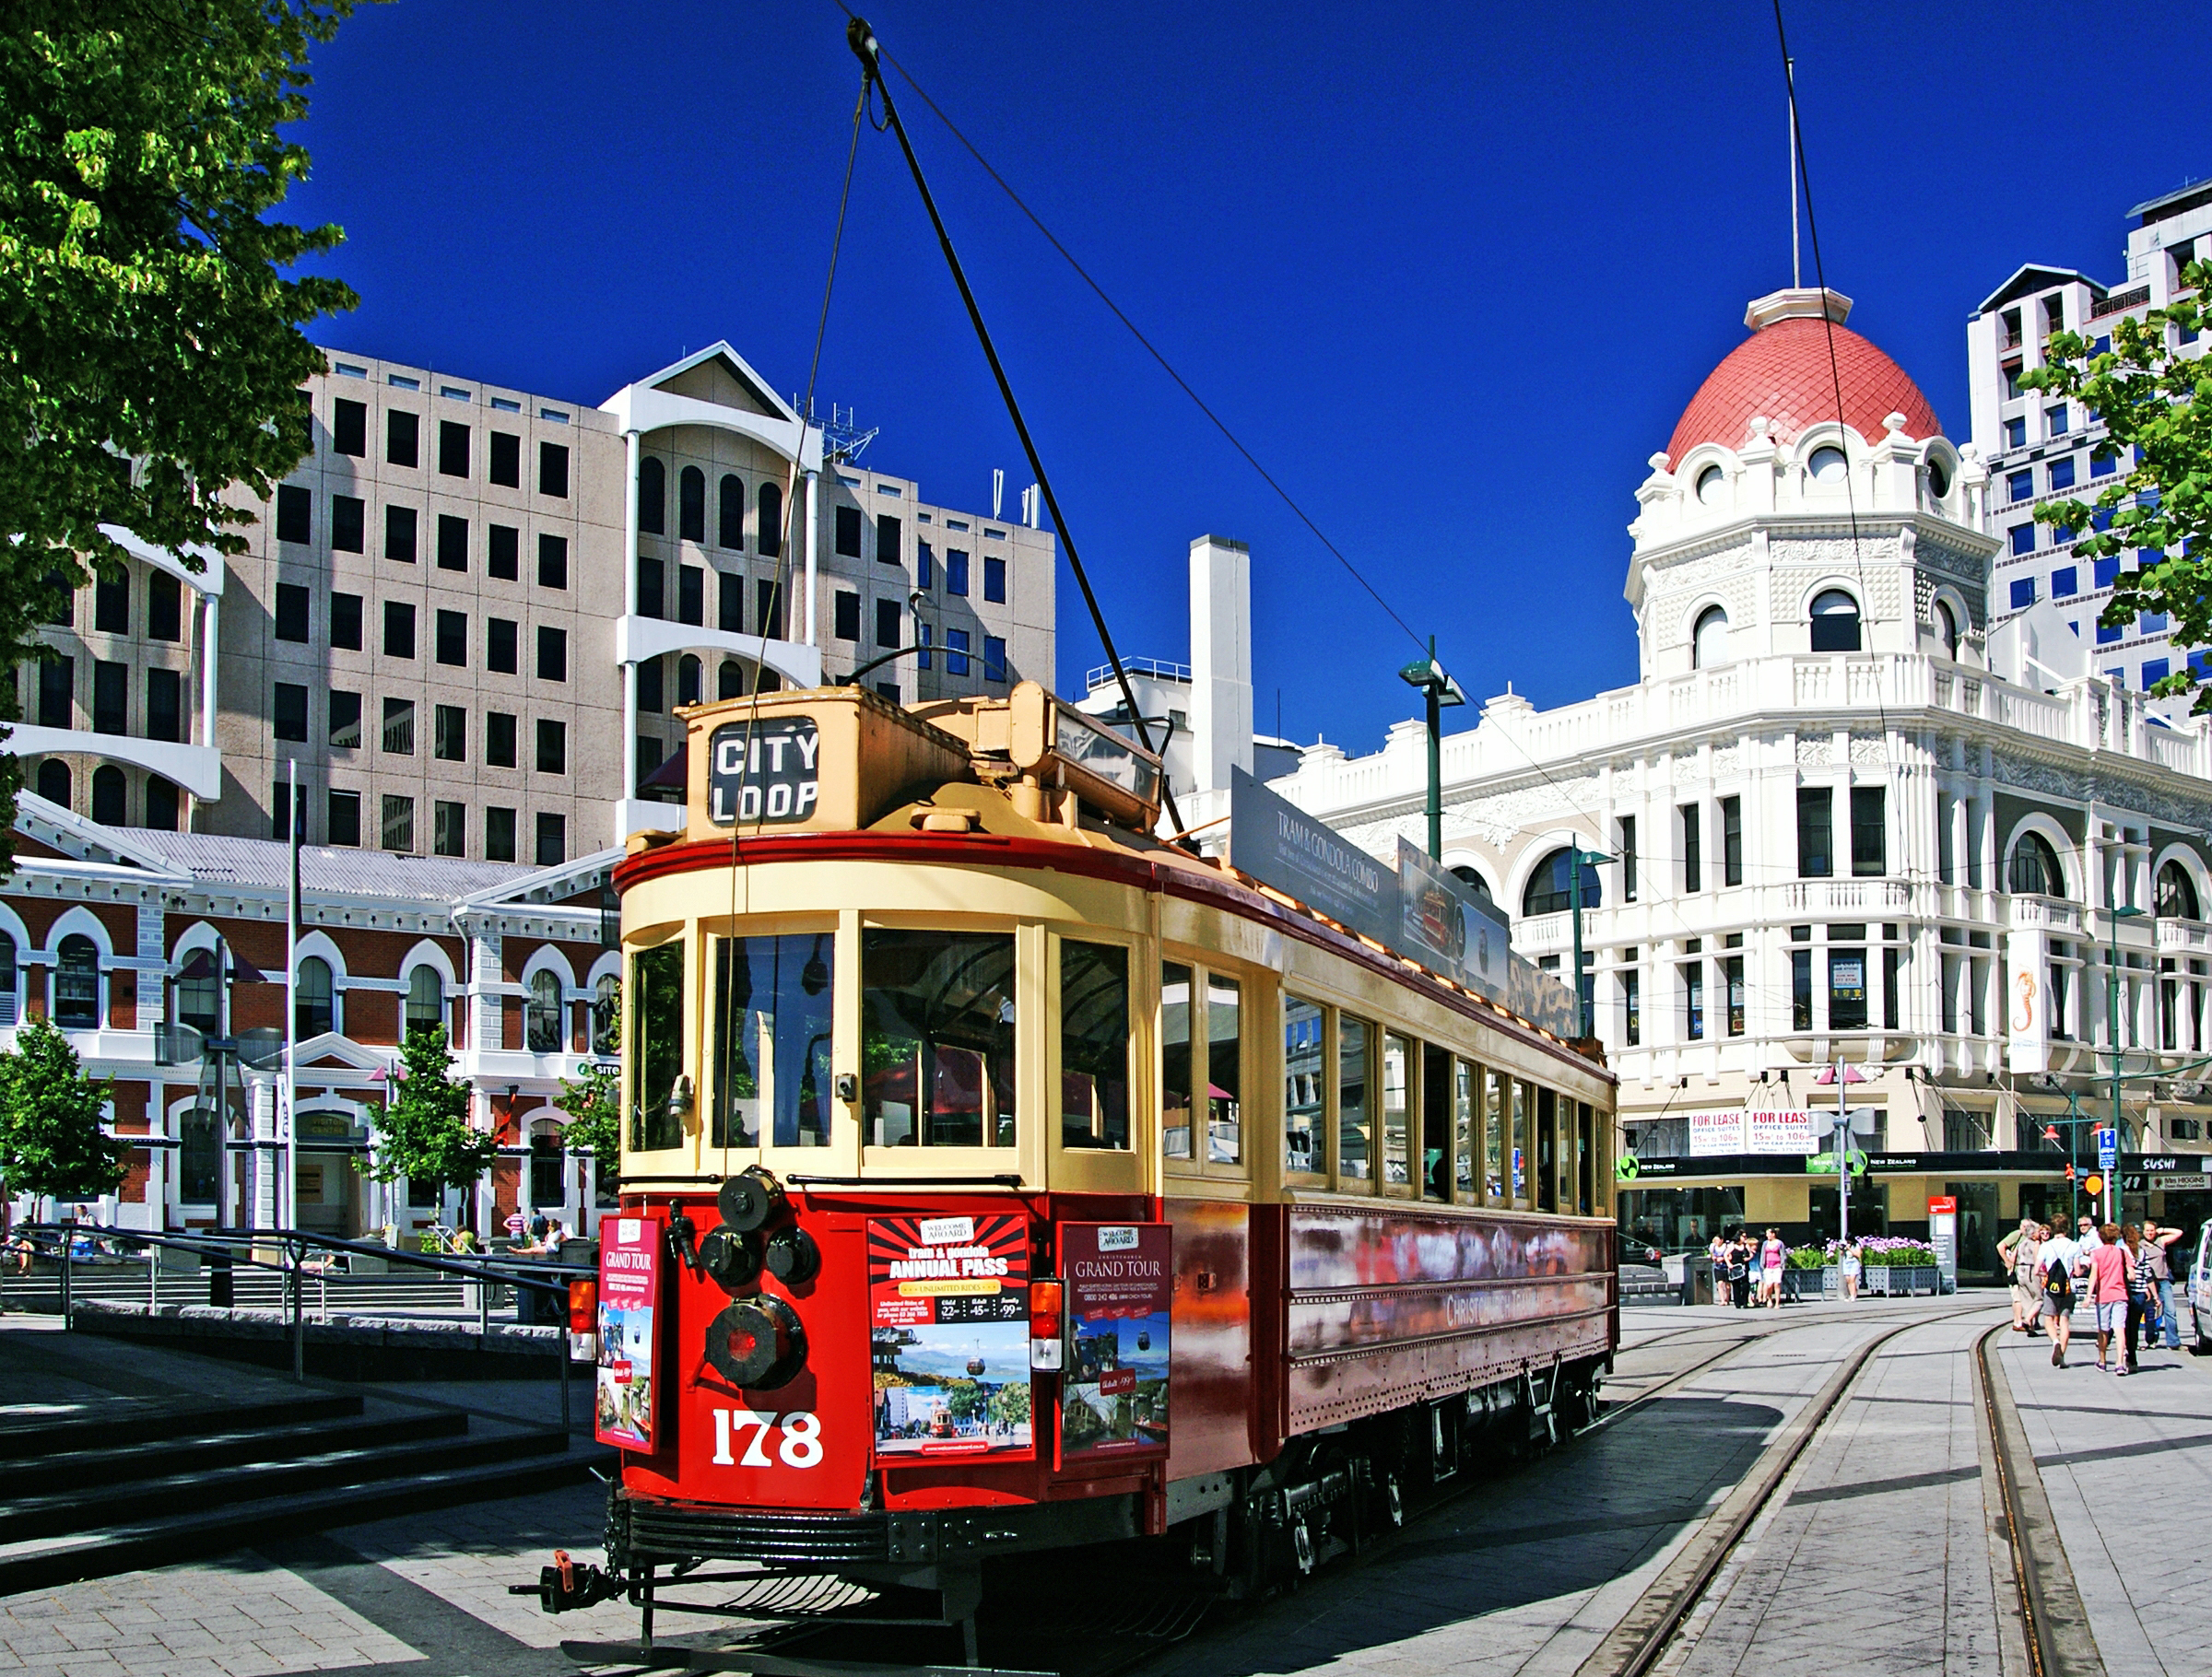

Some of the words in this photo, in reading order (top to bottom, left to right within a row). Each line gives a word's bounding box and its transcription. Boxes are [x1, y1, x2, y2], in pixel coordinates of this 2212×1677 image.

[717, 733, 819, 775] CITY
[712, 781, 818, 822] LOOP
[1277, 811, 1303, 848] TRAM
[1304, 827, 1312, 853] &
[1312, 833, 1351, 877] GONDOLA
[1352, 858, 1379, 894] COMBO
[1692, 1115, 1711, 1126] FOR
[1713, 1113, 1740, 1125] LEASE
[1753, 1112, 1775, 1123] FOR
[2104, 1131, 2112, 1139] P
[2142, 1157, 2176, 1170] SUSHI
[2178, 1176, 2205, 1184] HIGGINS
[926, 1222, 967, 1232] WELCOME
[1102, 1228, 1134, 1237] WELCOME
[928, 1230, 967, 1240] ABOARD
[1103, 1236, 1134, 1246] ABOARD
[909, 1247, 935, 1260] tram
[936, 1247, 946, 1260] &
[947, 1245, 990, 1260] gondola
[606, 1251, 631, 1269] GRAND
[631, 1253, 652, 1271] TOUR
[889, 1260, 960, 1279] ANNUAL
[962, 1257, 1008, 1277] PASS
[1076, 1261, 1124, 1278] GRAND
[1126, 1261, 1161, 1277] TOUR
[960, 1284, 981, 1292] RIDES
[712, 1409, 824, 1469] 178
